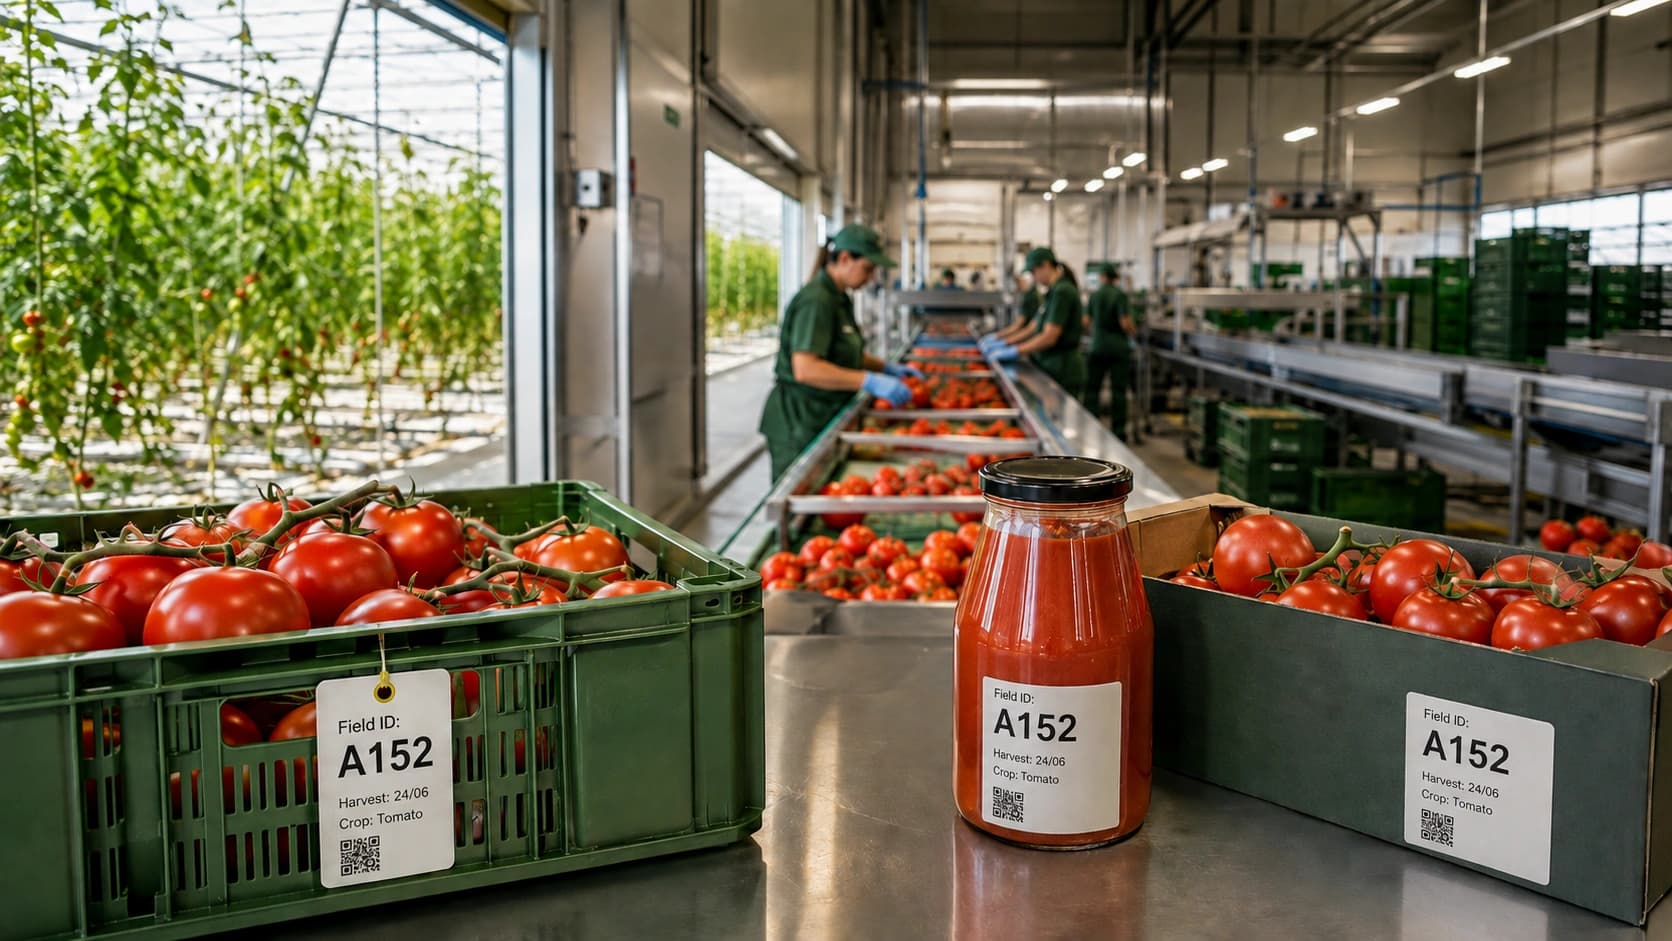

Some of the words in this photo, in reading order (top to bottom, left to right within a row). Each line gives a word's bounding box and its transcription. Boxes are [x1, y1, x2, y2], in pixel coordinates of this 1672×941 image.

[994, 688, 1017, 702] Field
[1021, 693, 1034, 704] ID:
[338, 717, 375, 734] Field
[380, 716, 400, 730] ID:
[994, 708, 1077, 742] A152
[1424, 708, 1450, 724] Field
[1454, 715, 1469, 728] ID:
[338, 736, 433, 778] A152
[994, 748, 1032, 763] Harvest:
[1036, 756, 1065, 766] 24/06
[1423, 730, 1509, 775] A152
[993, 766, 1018, 780] Crop:
[1021, 771, 1059, 784] Tomato
[1422, 771, 1464, 790] Harvest:
[1468, 782, 1499, 798] 24/06
[339, 793, 389, 808] Harvest:
[394, 787, 429, 802] 24/06
[1422, 789, 1449, 805] Crop:
[1453, 797, 1493, 815] Tomato
[339, 816, 373, 830] Crop:
[377, 810, 423, 825] Tomato
